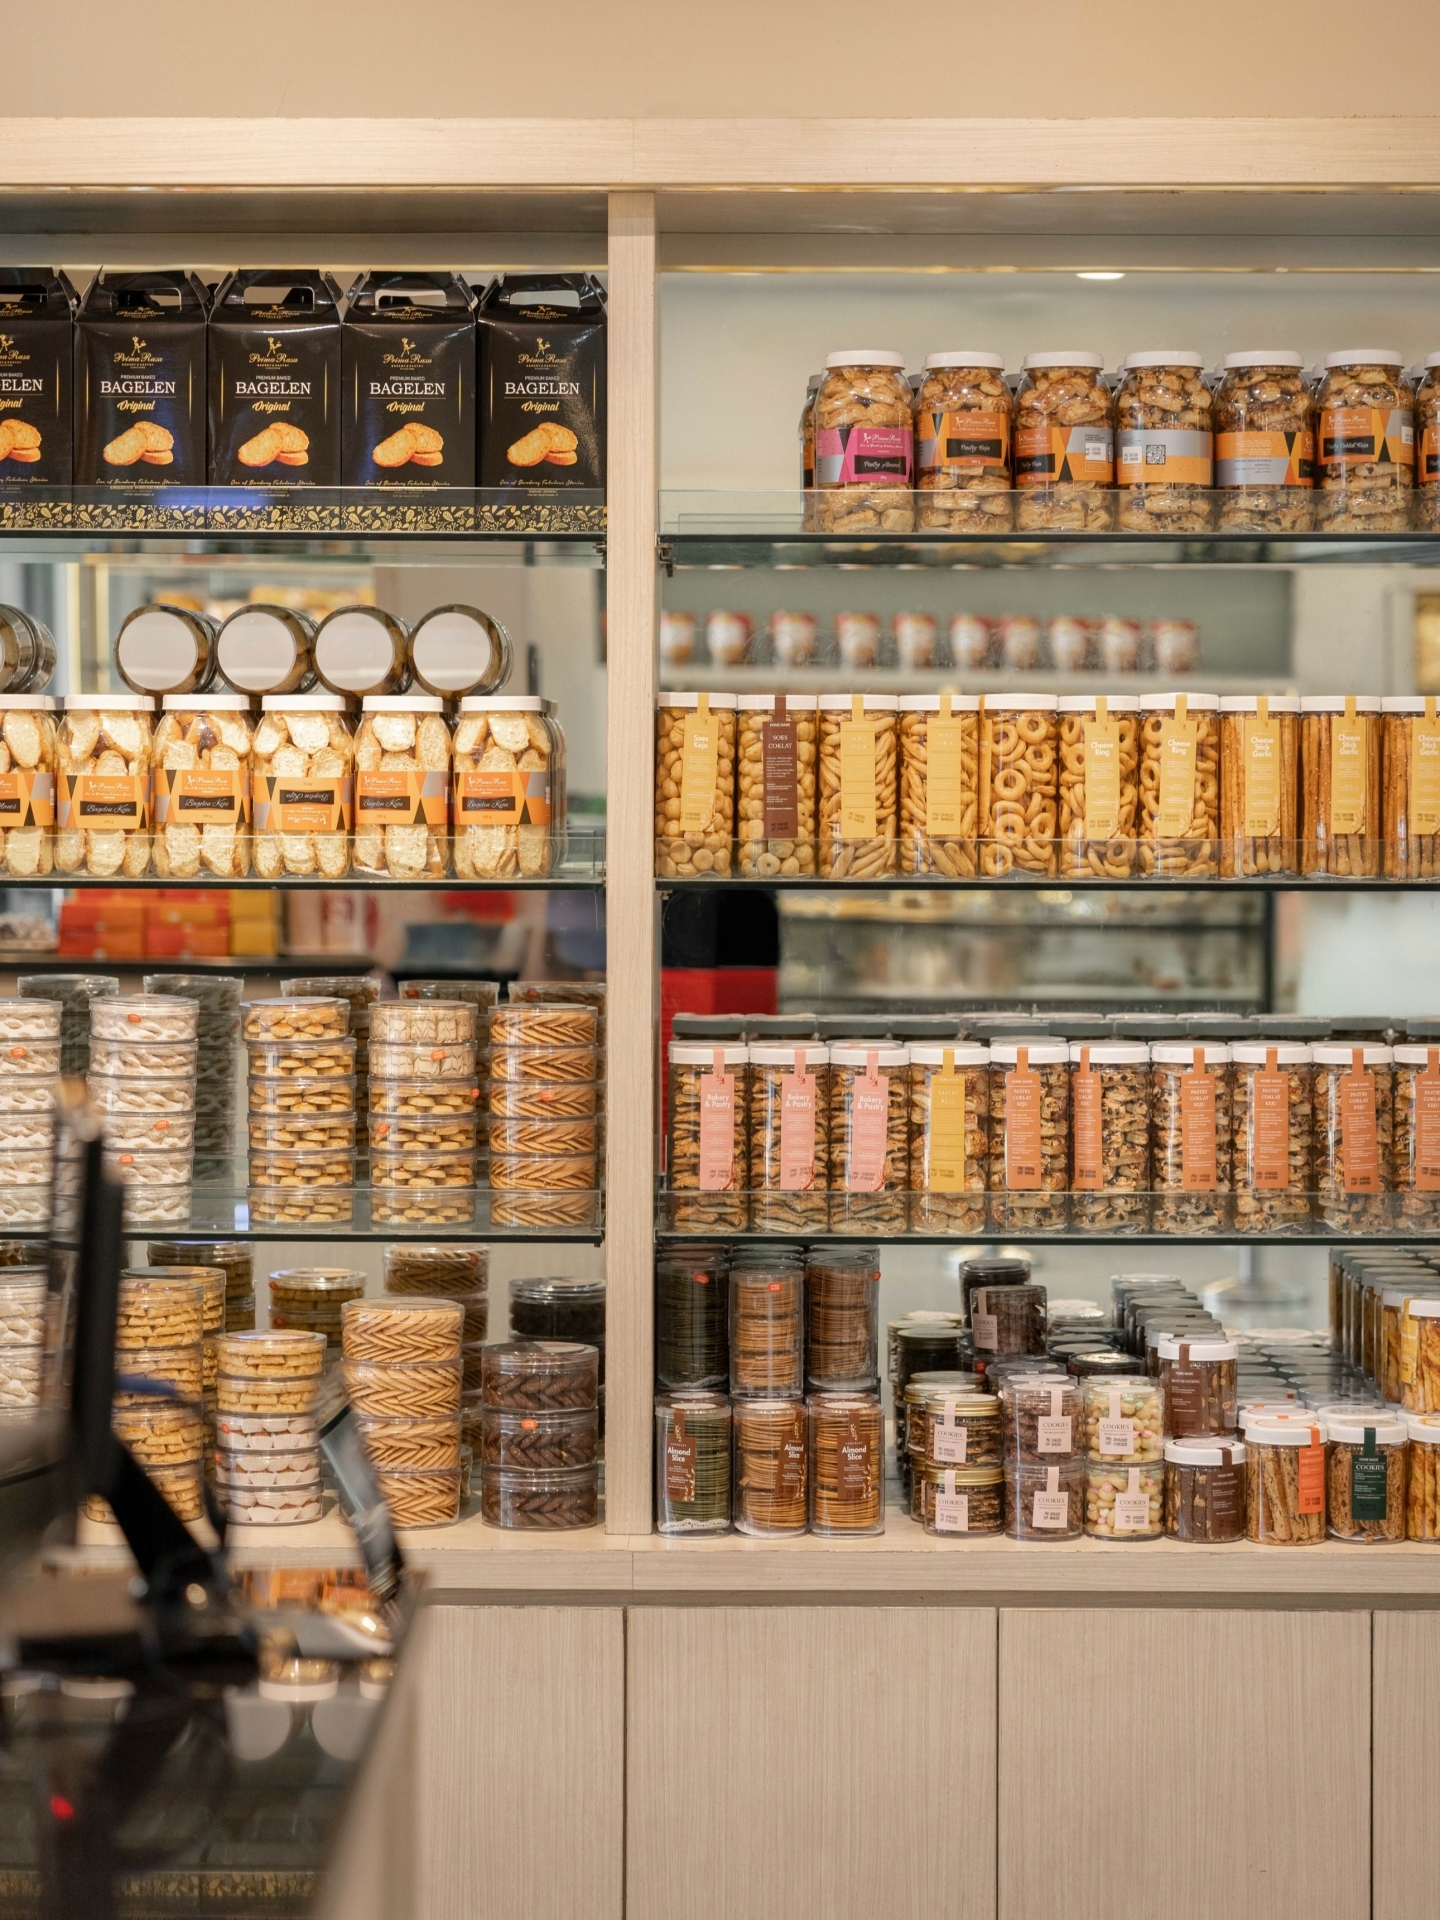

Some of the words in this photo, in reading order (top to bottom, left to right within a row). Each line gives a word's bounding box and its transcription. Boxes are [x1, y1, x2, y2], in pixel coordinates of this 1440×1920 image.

[8, 350, 30, 360] Rasa
[113, 352, 140, 363] Prima
[140, 352, 163, 363] Rasa
[249, 353, 275, 364] Prima
[276, 353, 298, 363] Rasa
[383, 353, 409, 364] Prima
[410, 353, 432, 364] Rasa
[518, 353, 544, 364] Prima
[545, 353, 567, 364] Rasa
[1, 379, 43, 391] ELEN
[100, 381, 176, 393] BAGELEN
[236, 382, 311, 394] BAGELEN
[370, 382, 445, 394] BAGELEN
[504, 382, 580, 394] BAGELEN
[117, 400, 155, 413] Original
[252, 401, 291, 414] Original
[386, 401, 425, 414] Original
[521, 401, 560, 414] Original
[693, 734, 709, 742] Soes
[1251, 736, 1274, 744] Cheese
[1418, 734, 1440, 742] Cheese
[693, 741, 709, 750] Keju
[1090, 741, 1113, 749] Cheese
[1167, 739, 1191, 747] Cheese
[1094, 749, 1109, 757] Ring
[1171, 747, 1186, 755] Ring
[1252, 750, 1272, 758] Garlic
[1420, 748, 1439, 756] Garlic
[185, 799, 211, 808] Bagelen
[87, 805, 113, 813] Bagelen
[860, 1096, 882, 1104] Bakery
[712, 1101, 731, 1109] Pastry
[793, 1101, 812, 1109] Pastry
[864, 1103, 884, 1111] Pastry
[938, 1430, 962, 1438] COOKIES
[668, 1447, 691, 1456] Almond
[784, 1444, 804, 1452] Almond
[842, 1445, 867, 1453] Almond
[672, 1454, 685, 1462] Slice
[788, 1451, 800, 1459] Slice
[848, 1453, 862, 1461] Slice
